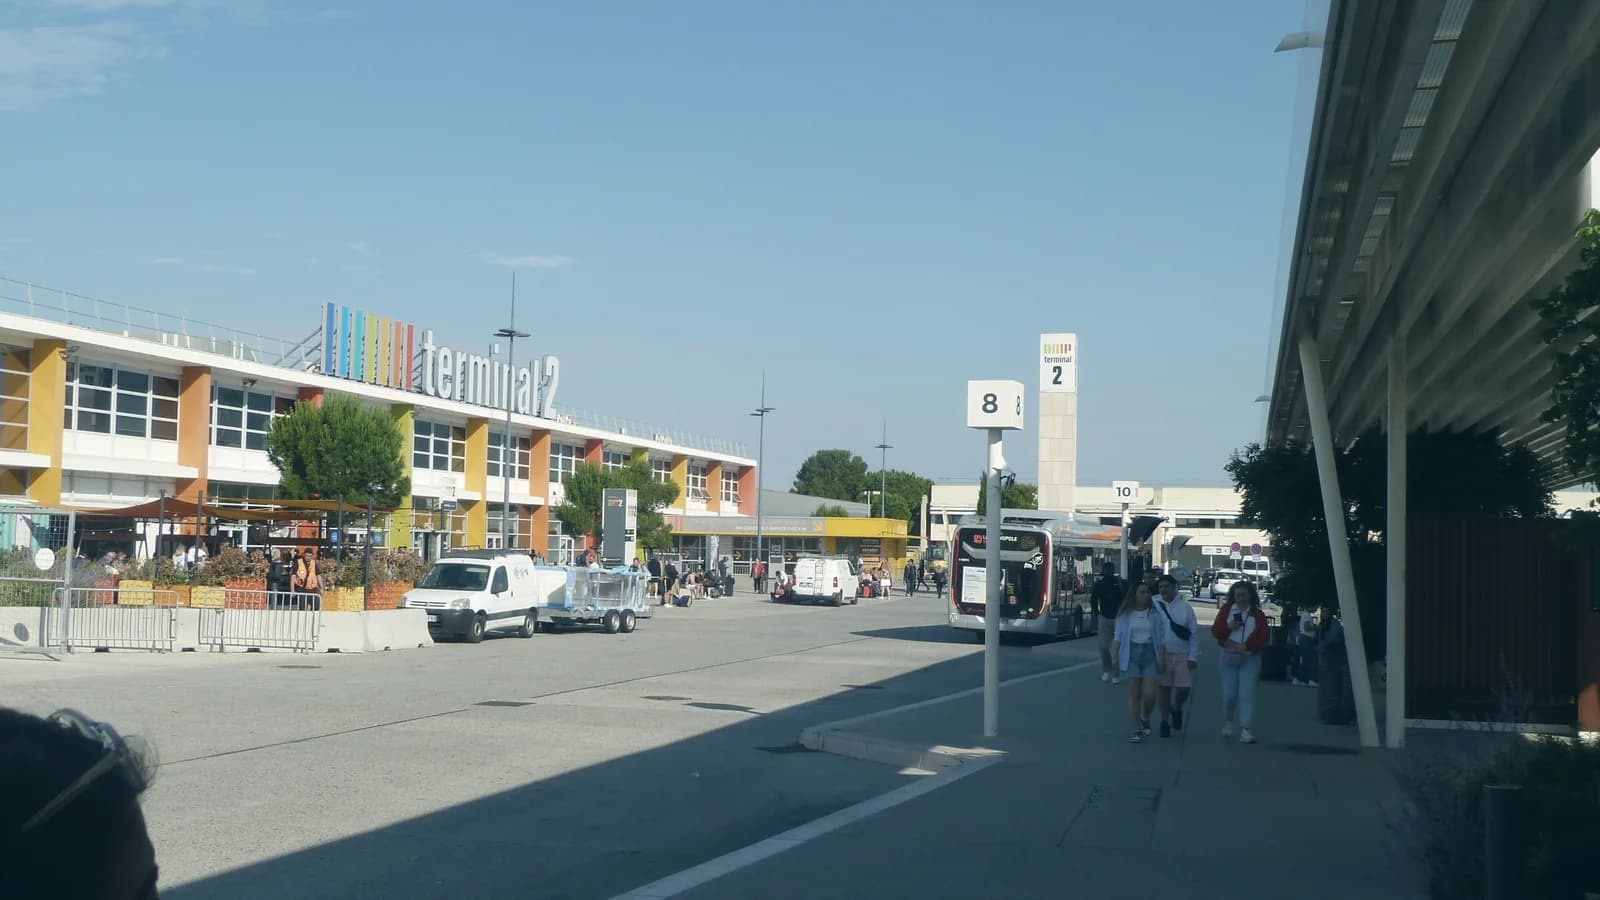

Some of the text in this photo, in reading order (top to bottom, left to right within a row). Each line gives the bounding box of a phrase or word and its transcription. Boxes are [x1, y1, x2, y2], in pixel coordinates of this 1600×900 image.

[1043, 355, 1072, 363] terminal
[422, 329, 560, 419] terminal 2
[1052, 365, 1063, 385] 2
[982, 392, 999, 414] 8
[1015, 395, 1022, 416] 8
[1116, 486, 1131, 497] 10
